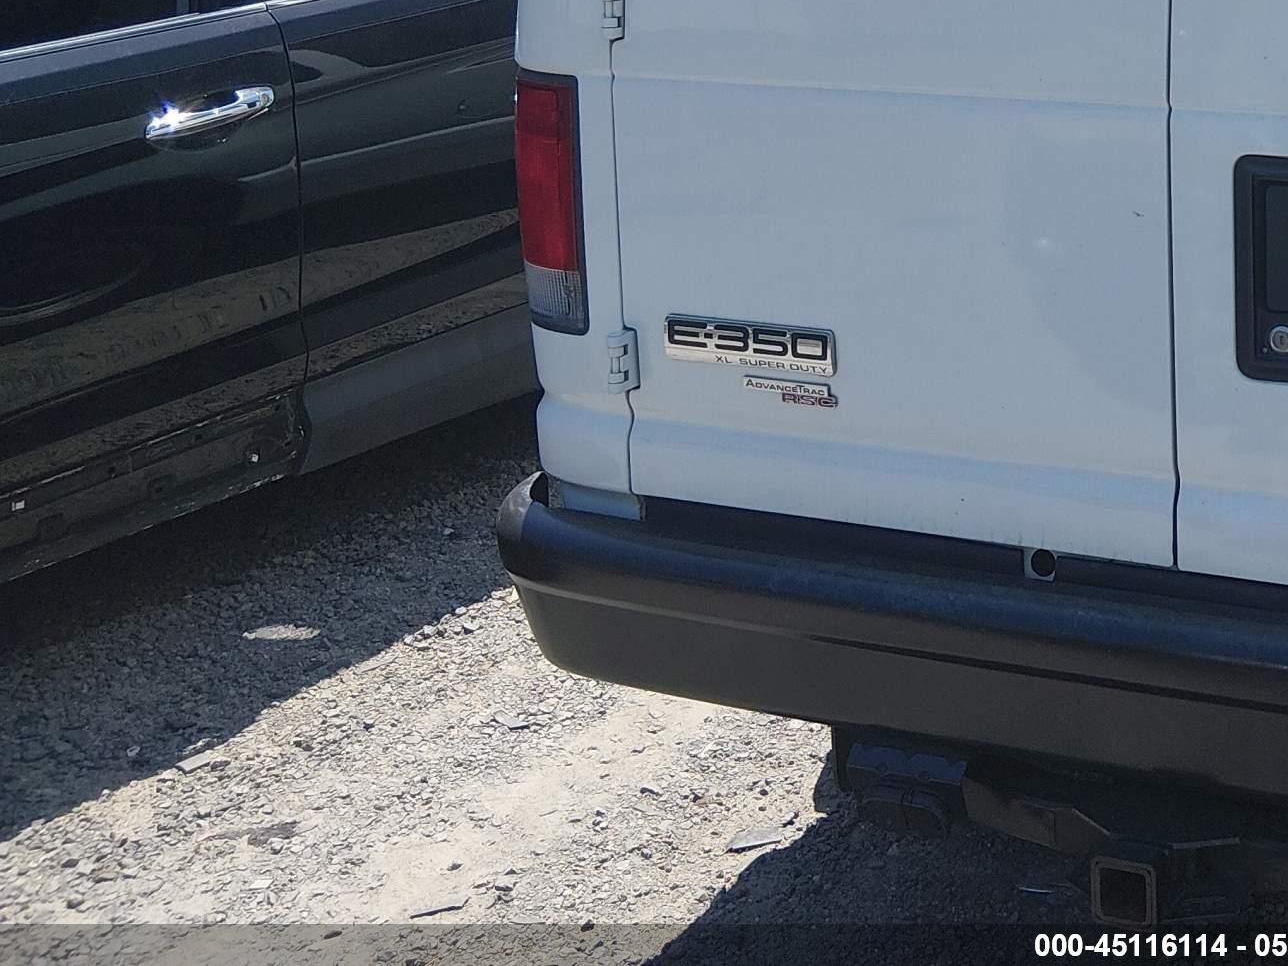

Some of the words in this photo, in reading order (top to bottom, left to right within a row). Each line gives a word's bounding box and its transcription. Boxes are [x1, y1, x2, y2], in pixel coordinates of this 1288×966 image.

[667, 320, 829, 361] E-350
[715, 355, 733, 364] XL
[739, 358, 786, 370] SUPER
[789, 363, 828, 375] DUTY
